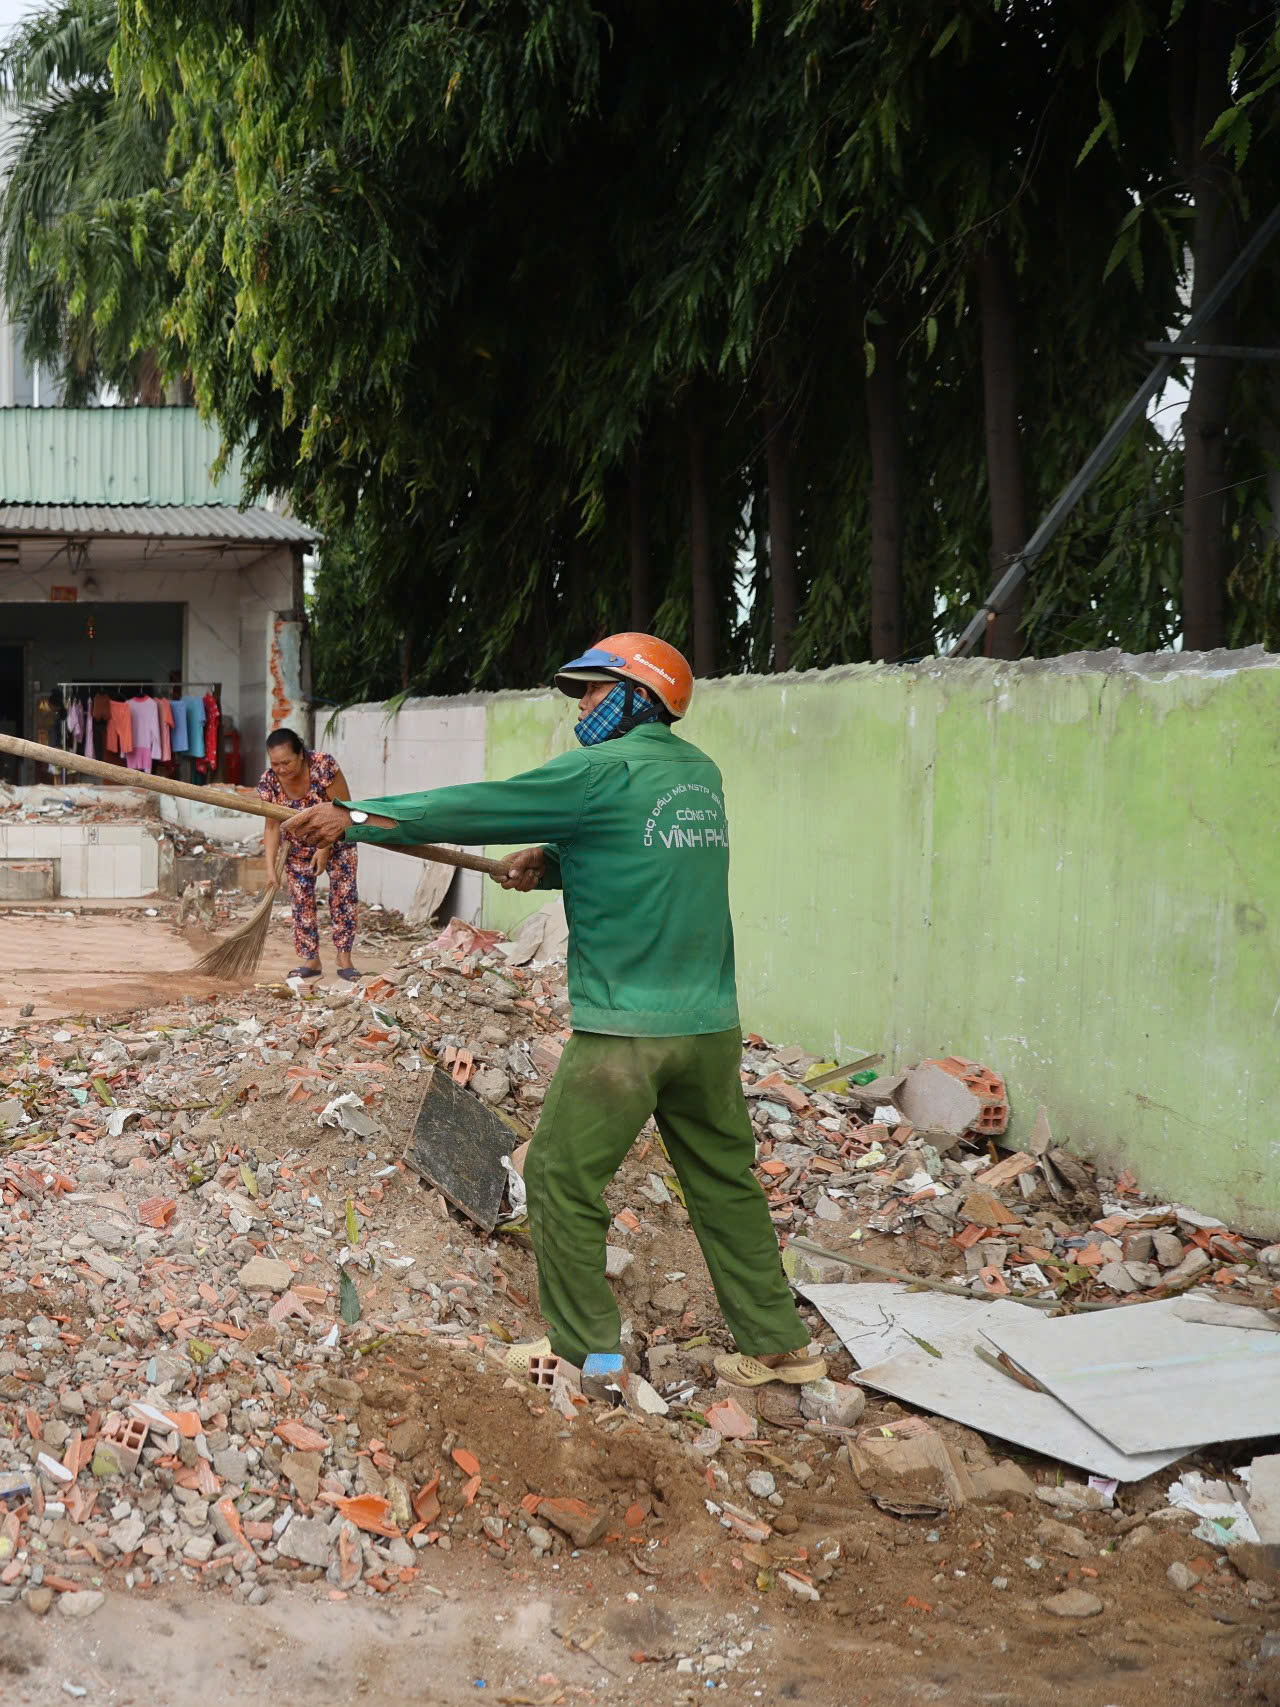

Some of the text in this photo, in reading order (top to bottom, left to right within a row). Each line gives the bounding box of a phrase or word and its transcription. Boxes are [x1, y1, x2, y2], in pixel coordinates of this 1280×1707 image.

[676, 808, 718, 821] CÔNG TY
[658, 824, 703, 849] VĨNH
